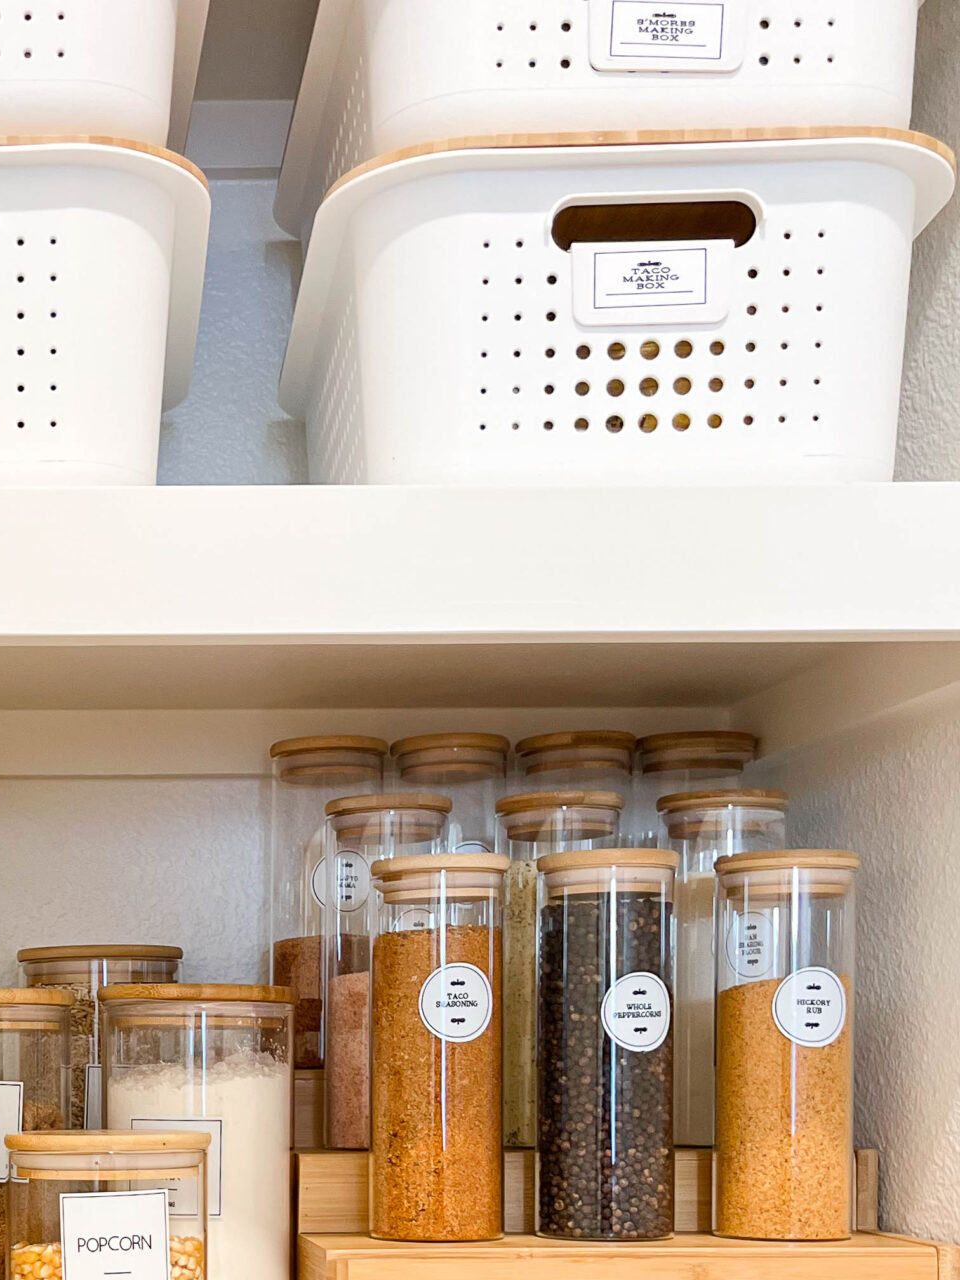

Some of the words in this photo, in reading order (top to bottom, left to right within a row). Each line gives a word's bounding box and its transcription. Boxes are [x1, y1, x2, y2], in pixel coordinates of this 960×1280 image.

[638, 26, 694, 34] MAKING
[651, 34, 680, 42] BOX
[631, 266, 671, 275] TACO
[622, 274, 680, 283] MAKING
[636, 282, 665, 290] BOX
[446, 992, 469, 1000] TACO
[806, 1006, 822, 1014] RUB
[77, 1234, 153, 1253] POPCORN
